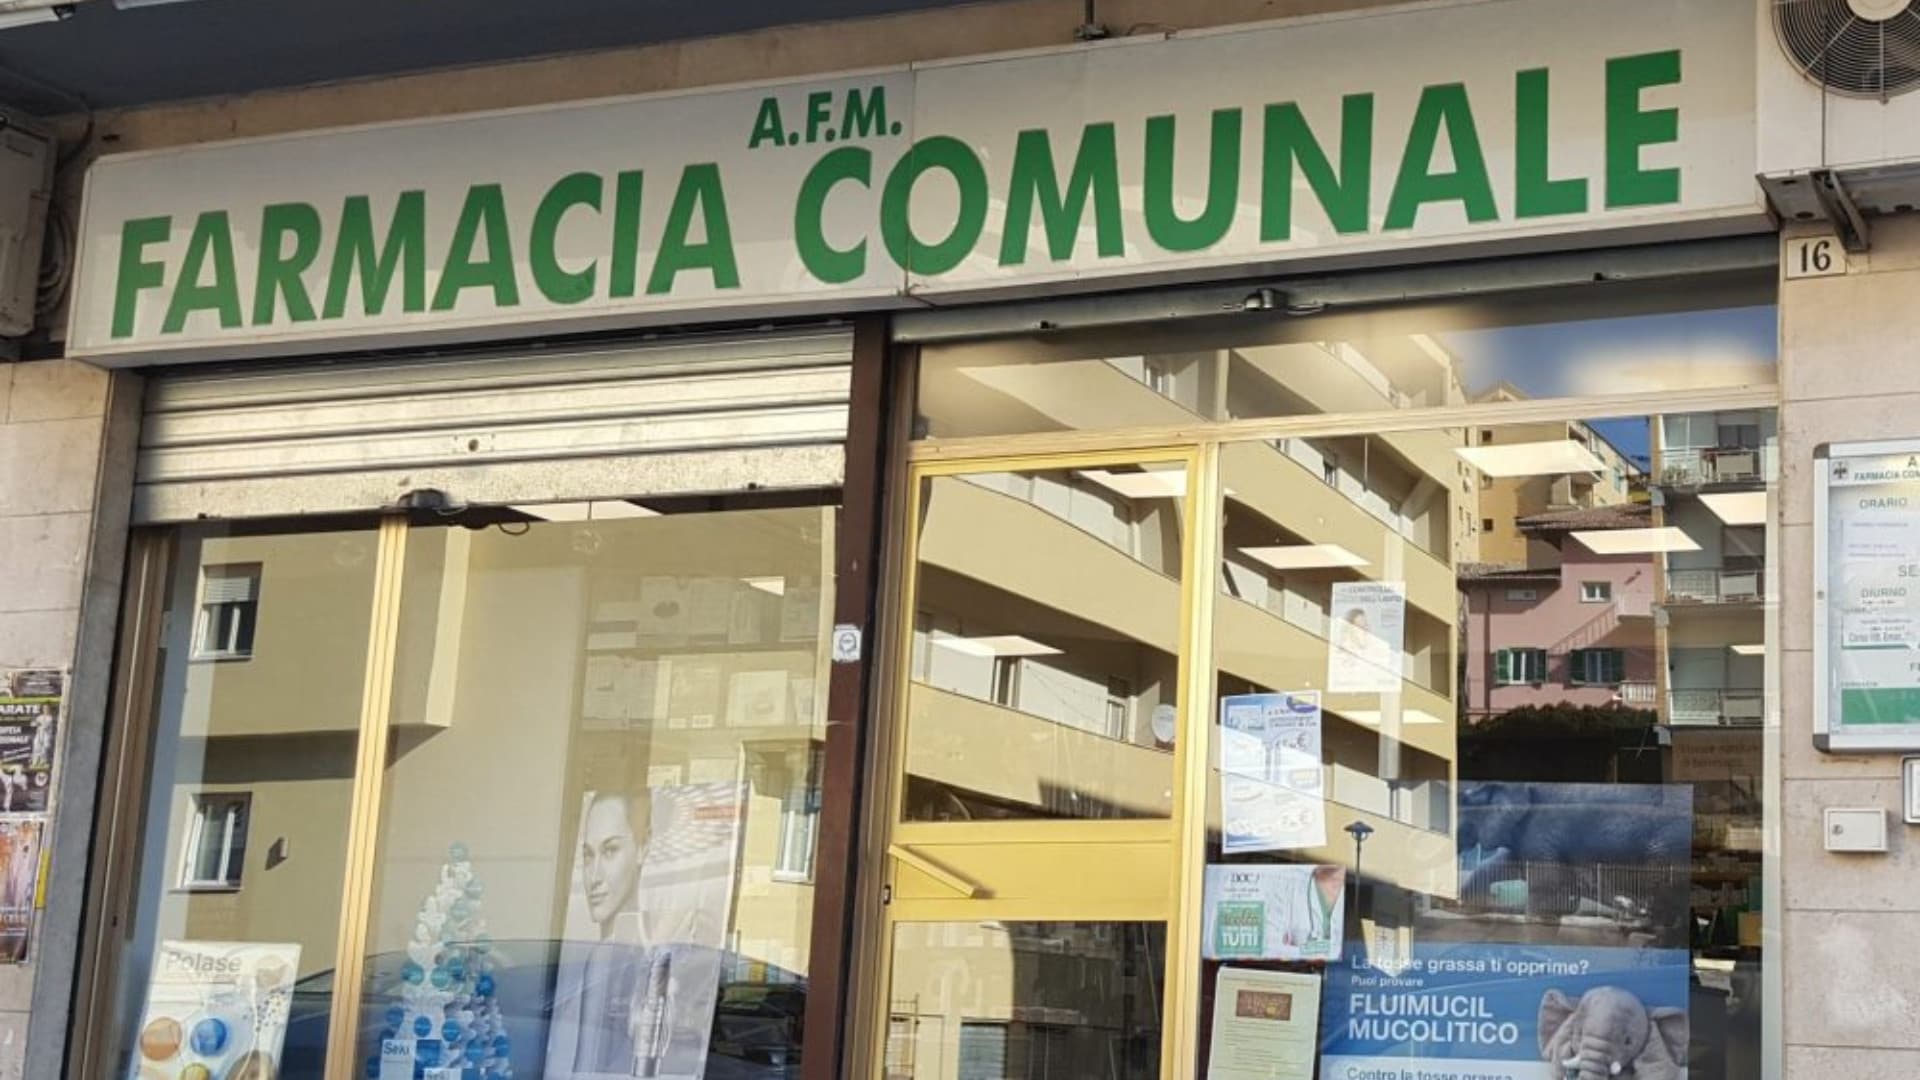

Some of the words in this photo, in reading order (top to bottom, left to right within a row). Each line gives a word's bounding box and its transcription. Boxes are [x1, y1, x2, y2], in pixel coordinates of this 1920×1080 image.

[748, 85, 903, 149] A.F.M.
[111, 162, 741, 339] FARMACIA
[794, 50, 1681, 285] COMUNALE
[1799, 240, 1831, 273] 16
[1854, 469, 1900, 481] FARMACIA
[1859, 497, 1908, 510] ORARIO
[1861, 587, 1907, 599] DIURNO
[166, 951, 241, 973] Polase
[1351, 956, 1371, 970] La
[1427, 957, 1486, 974] grassa
[1490, 957, 1502, 972] ti
[1506, 959, 1590, 976] opprime?
[1351, 975, 1377, 987] Puoi
[1379, 976, 1425, 989] provare
[1349, 993, 1494, 1019] FLUIMUCIL
[1347, 1018, 1519, 1045] MUCOLITICO
[1346, 1067, 1398, 1080] Contro
[1401, 1068, 1414, 1080] la
